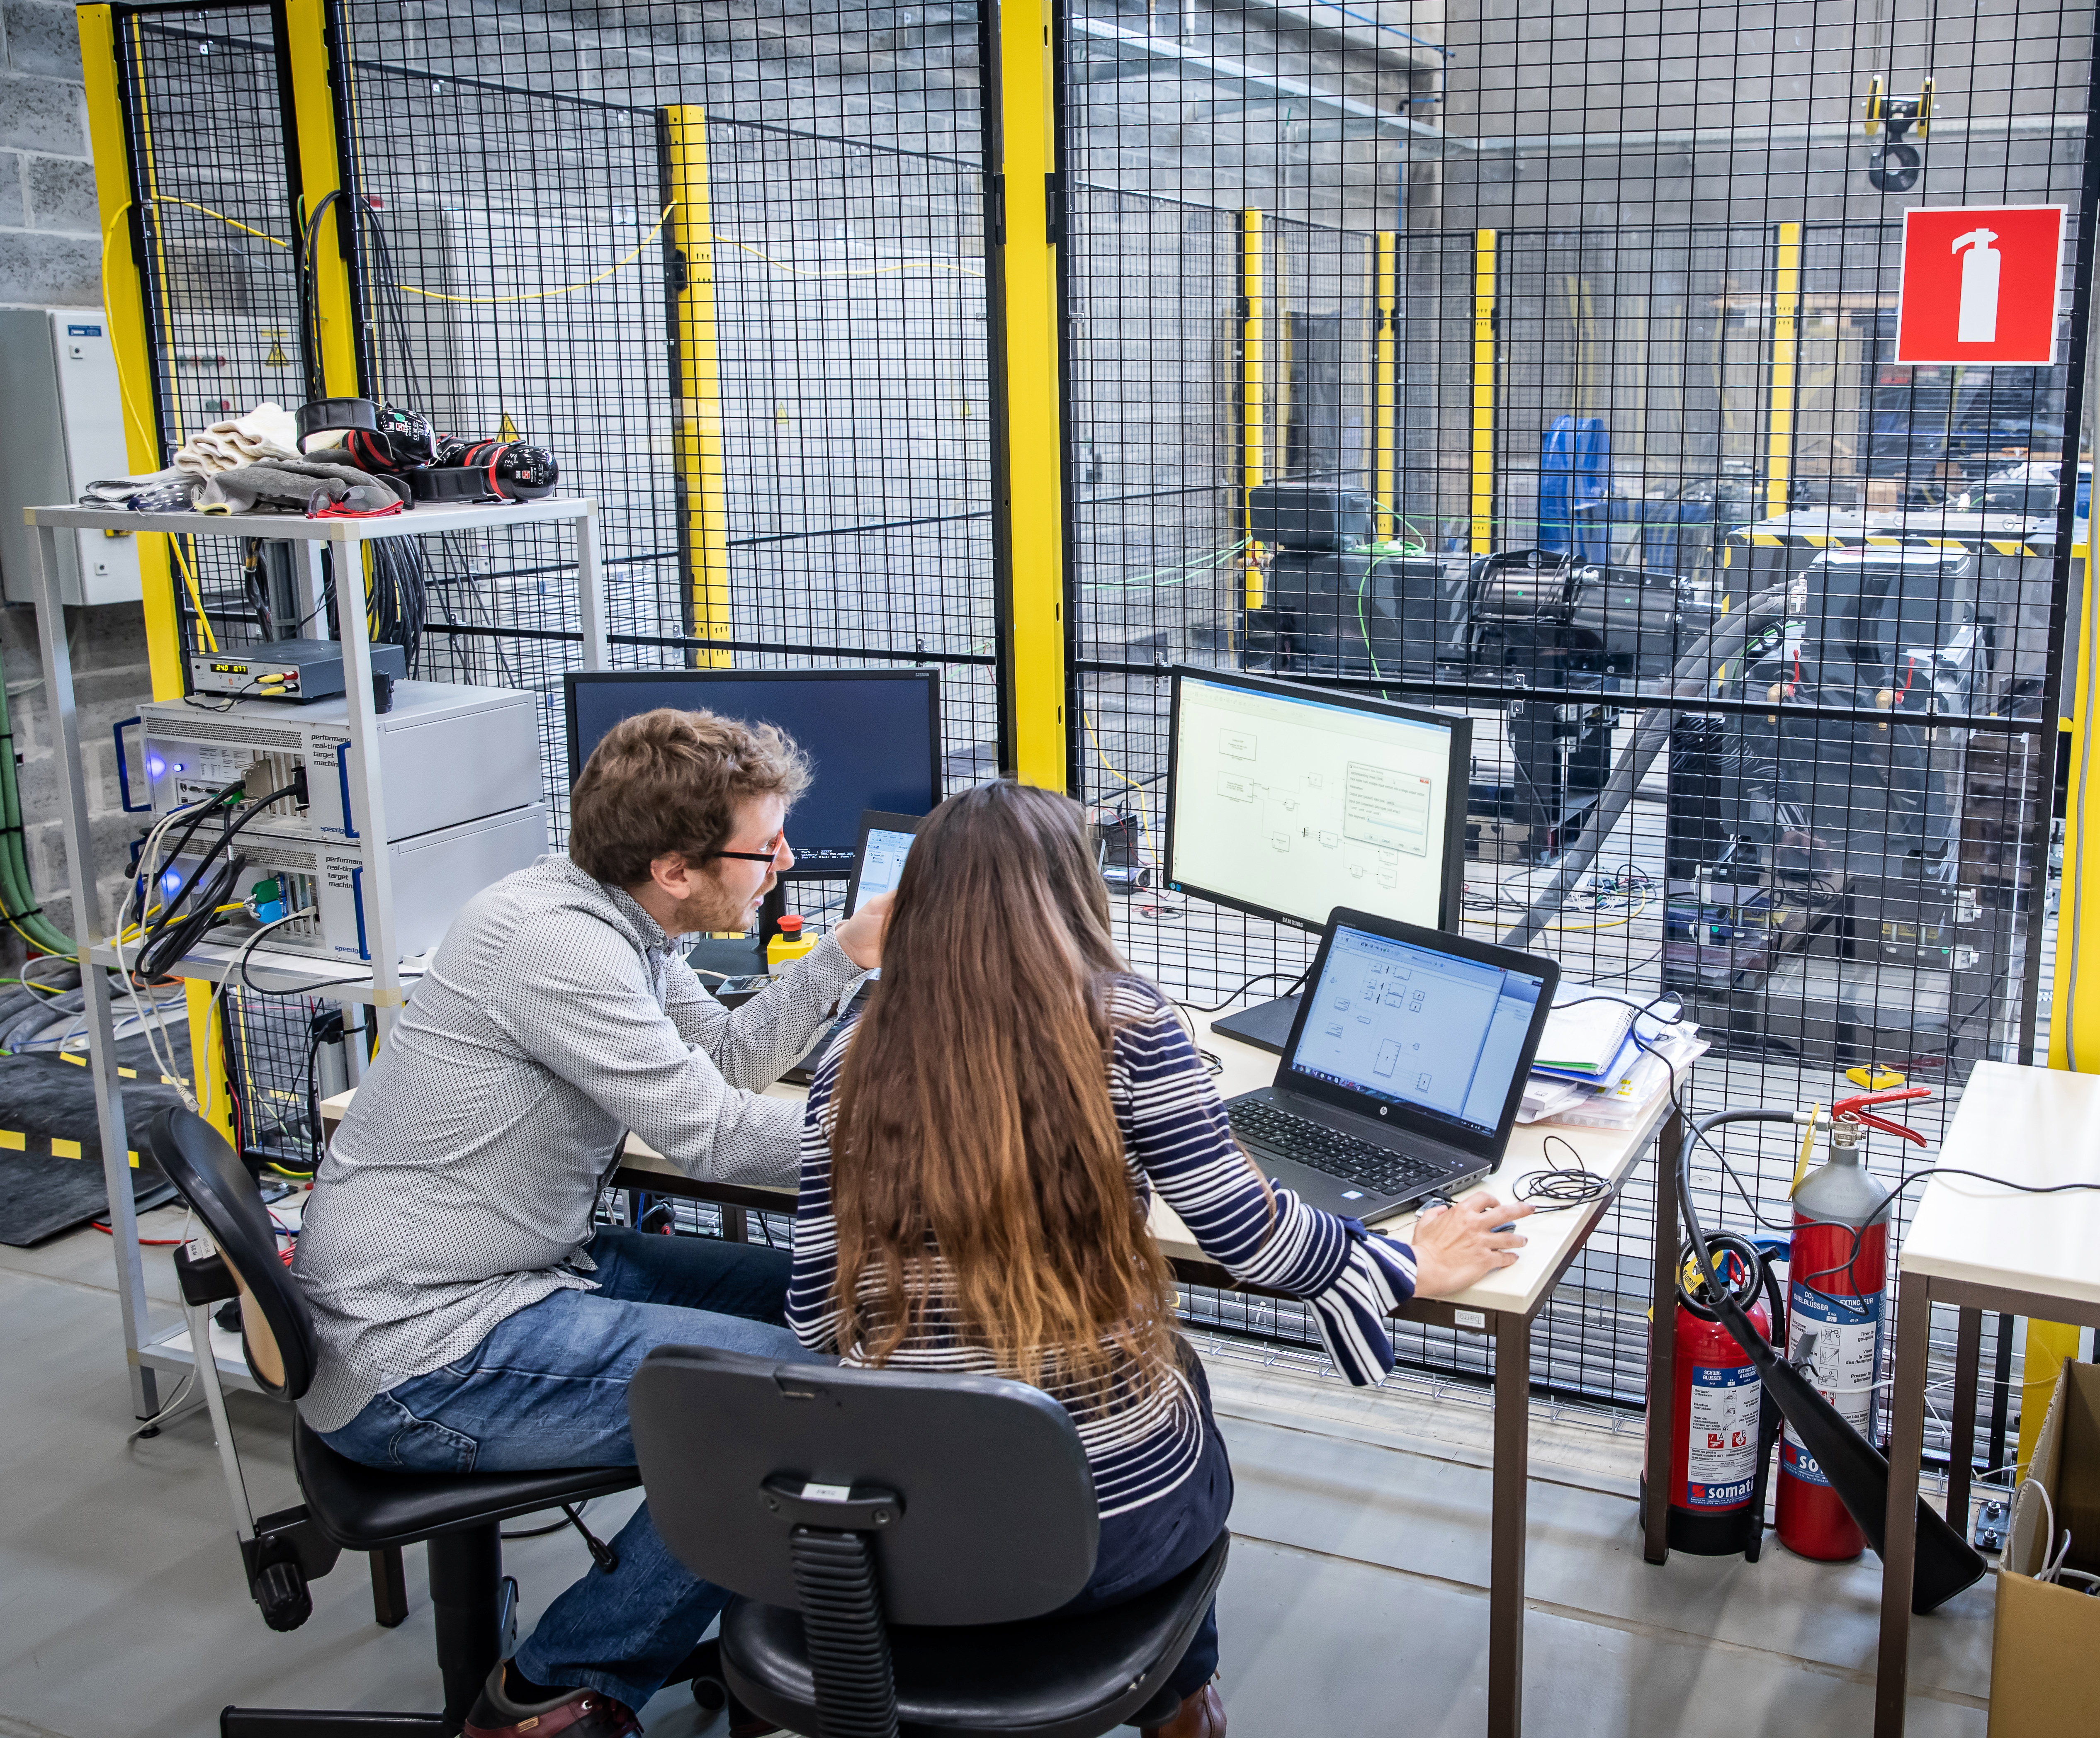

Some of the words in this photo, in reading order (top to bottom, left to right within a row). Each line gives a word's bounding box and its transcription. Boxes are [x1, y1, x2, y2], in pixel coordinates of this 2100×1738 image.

[1282, 917, 1303, 927] SAMSUNG
[335, 946, 358, 954] speedg
[1683, 1274, 1697, 1289] somati
[1794, 1293, 1828, 1311] SNELBLUSSER
[1792, 1318, 1806, 1329] Borgpen
[1708, 1476, 1754, 1498] somati
